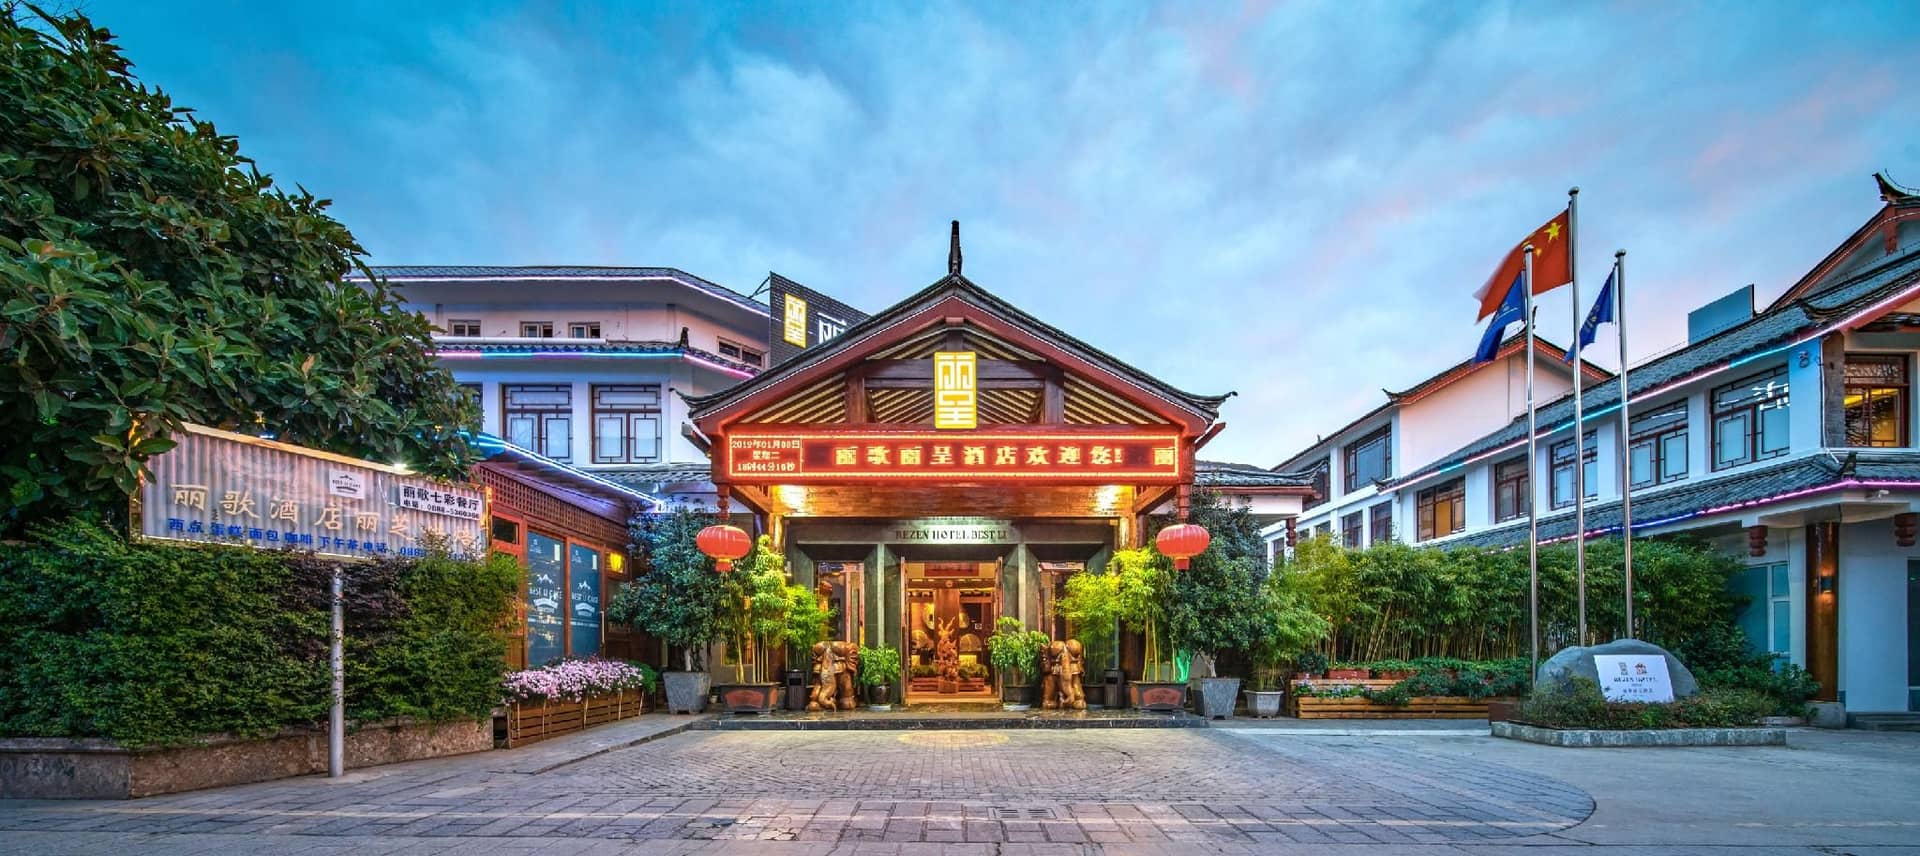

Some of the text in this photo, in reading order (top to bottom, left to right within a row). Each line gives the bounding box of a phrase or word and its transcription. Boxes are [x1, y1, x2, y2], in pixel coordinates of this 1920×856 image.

[403, 485, 480, 511] 丽歌七彩餐厅
[932, 530, 970, 540] HOTEL
